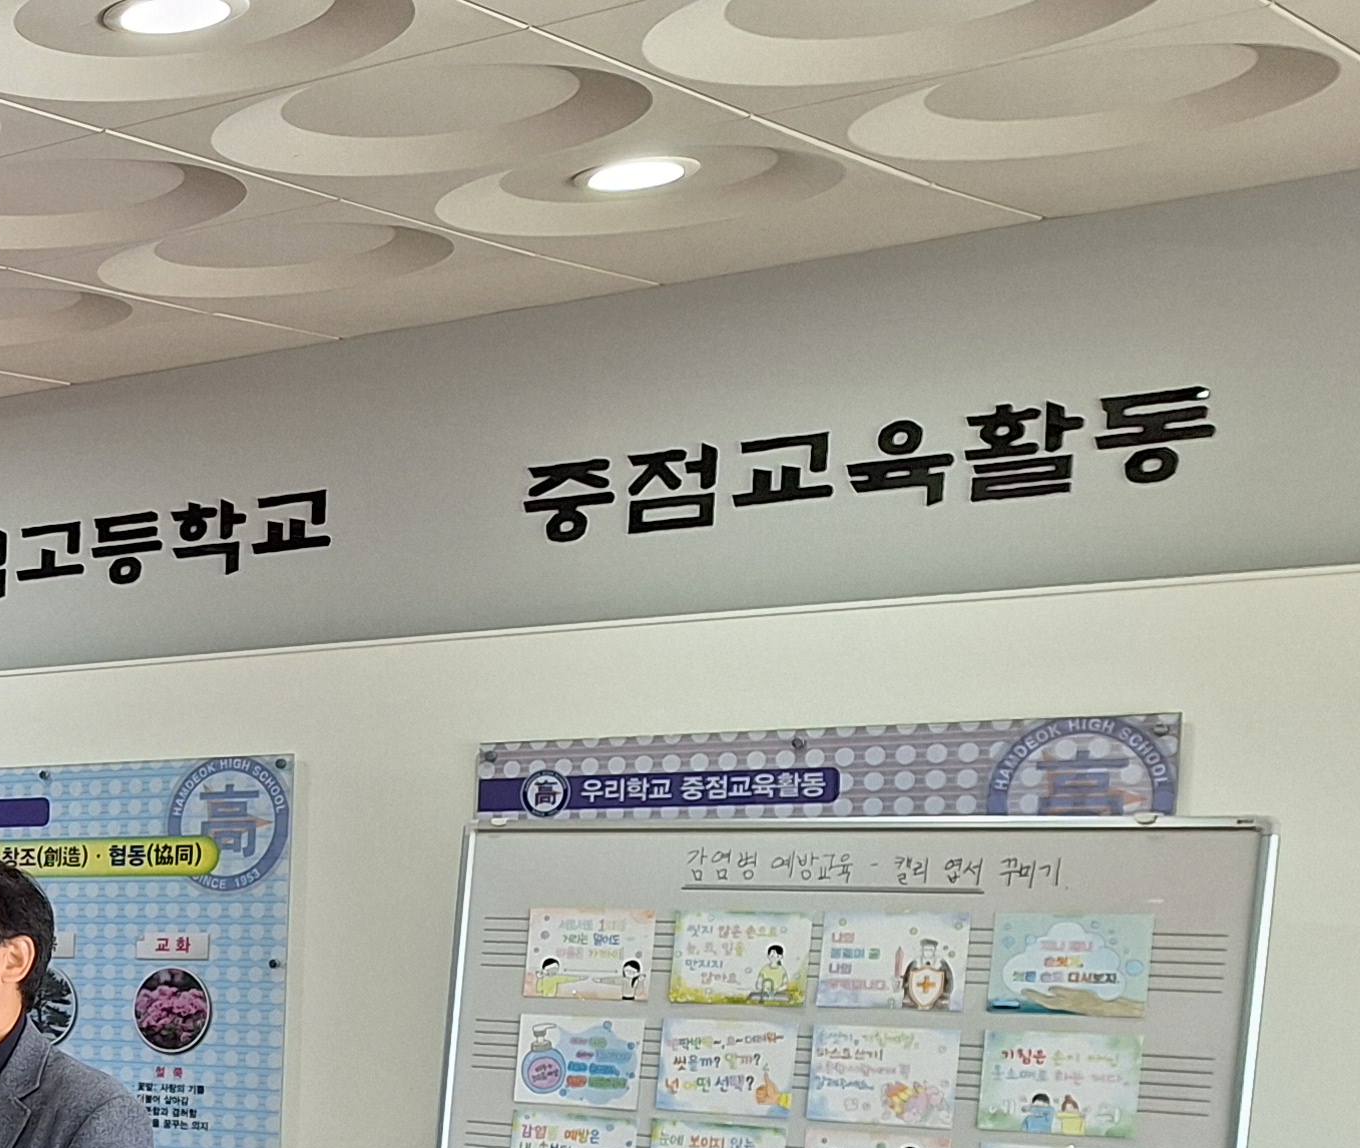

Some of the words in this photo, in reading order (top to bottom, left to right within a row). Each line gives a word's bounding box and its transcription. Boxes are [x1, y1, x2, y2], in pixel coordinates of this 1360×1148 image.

[523, 386, 1217, 543] 중점교육활동
[994, 725, 1063, 791] HAMDEOK
[1068, 718, 1115, 734] HIGH
[1119, 726, 1169, 786] SCHOOL
[172, 762, 217, 817] HAMDEOK
[220, 758, 251, 772] HIGH
[251, 765, 285, 814] SCHOOL
[581, 777, 672, 803] 우리학교
[680, 772, 826, 800] 중점교육활동
[109, 842, 202, 868] 협동(協同)
[771, 850, 854, 884] 예방교육
[944, 857, 983, 886] 엽서
[192, 874, 226, 889] SINCE
[235, 869, 261, 889] 1953
